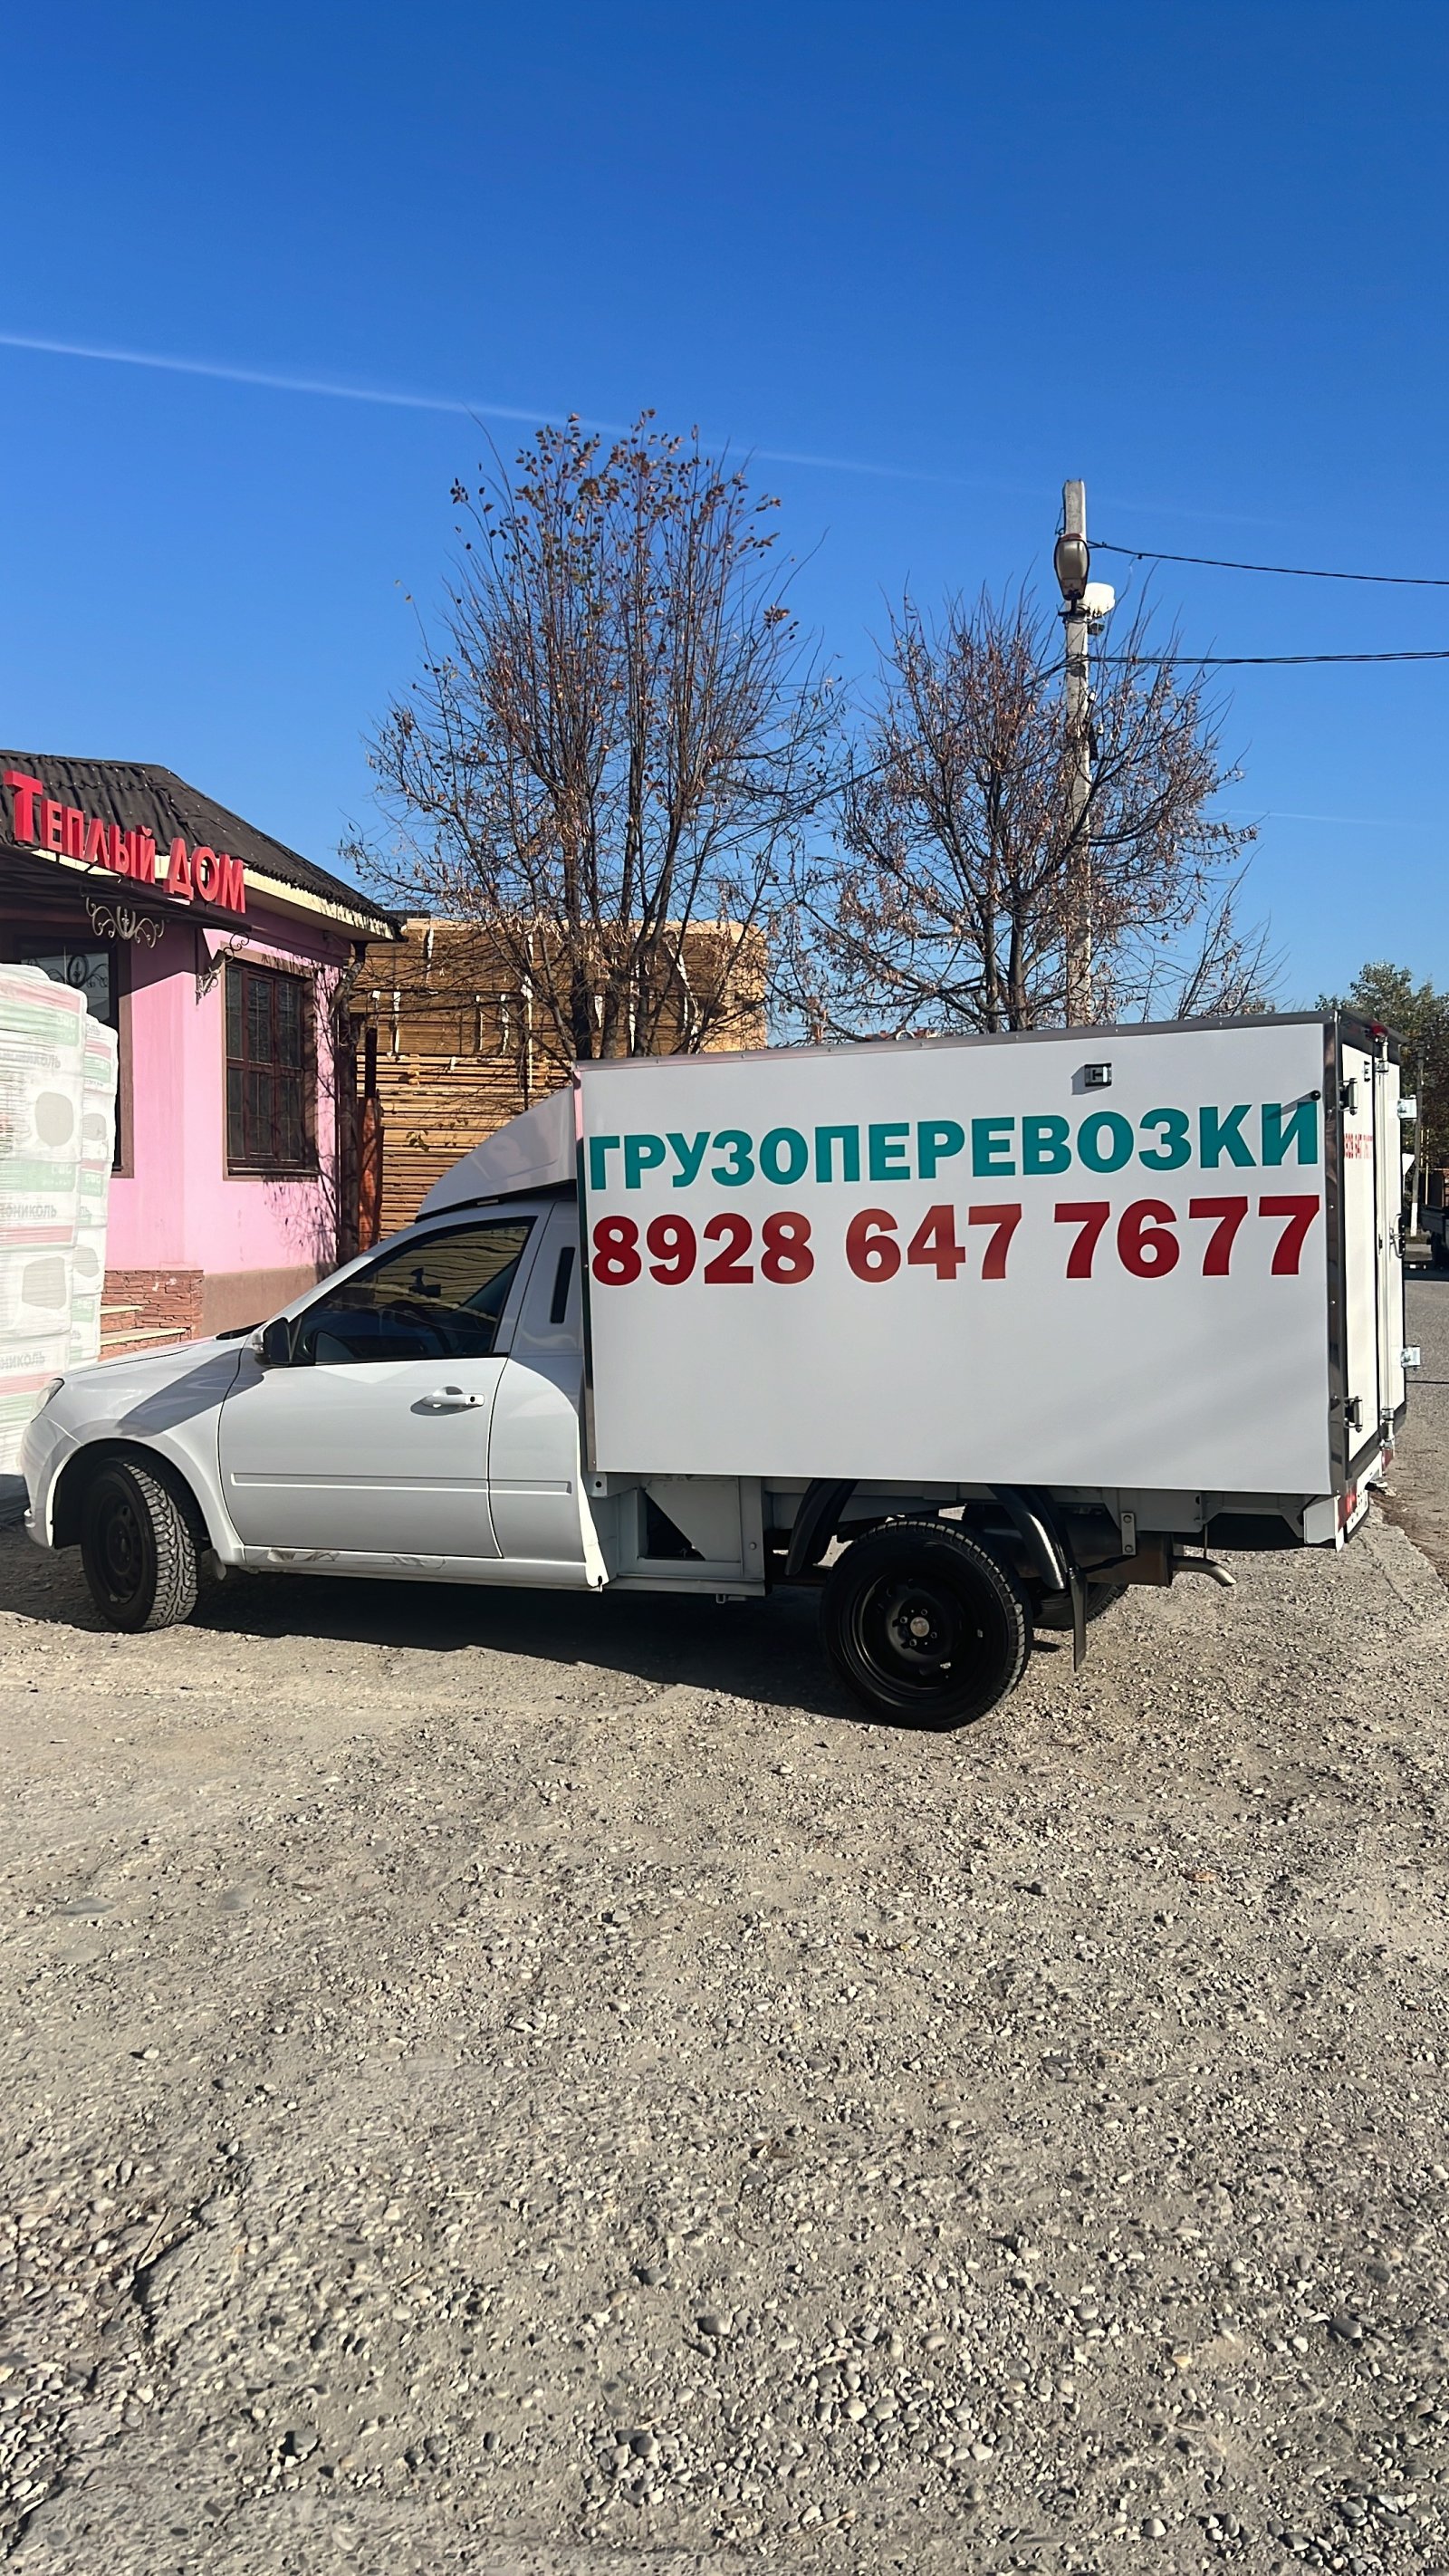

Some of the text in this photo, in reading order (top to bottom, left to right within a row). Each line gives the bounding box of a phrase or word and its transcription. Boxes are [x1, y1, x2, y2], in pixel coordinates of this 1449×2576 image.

[162, 837, 246, 915] ДОМ
[588, 1101, 1319, 1190] ГРУЗОПЕРЕВОЗКИ
[591, 1195, 1320, 1286] 8928 647 7677
